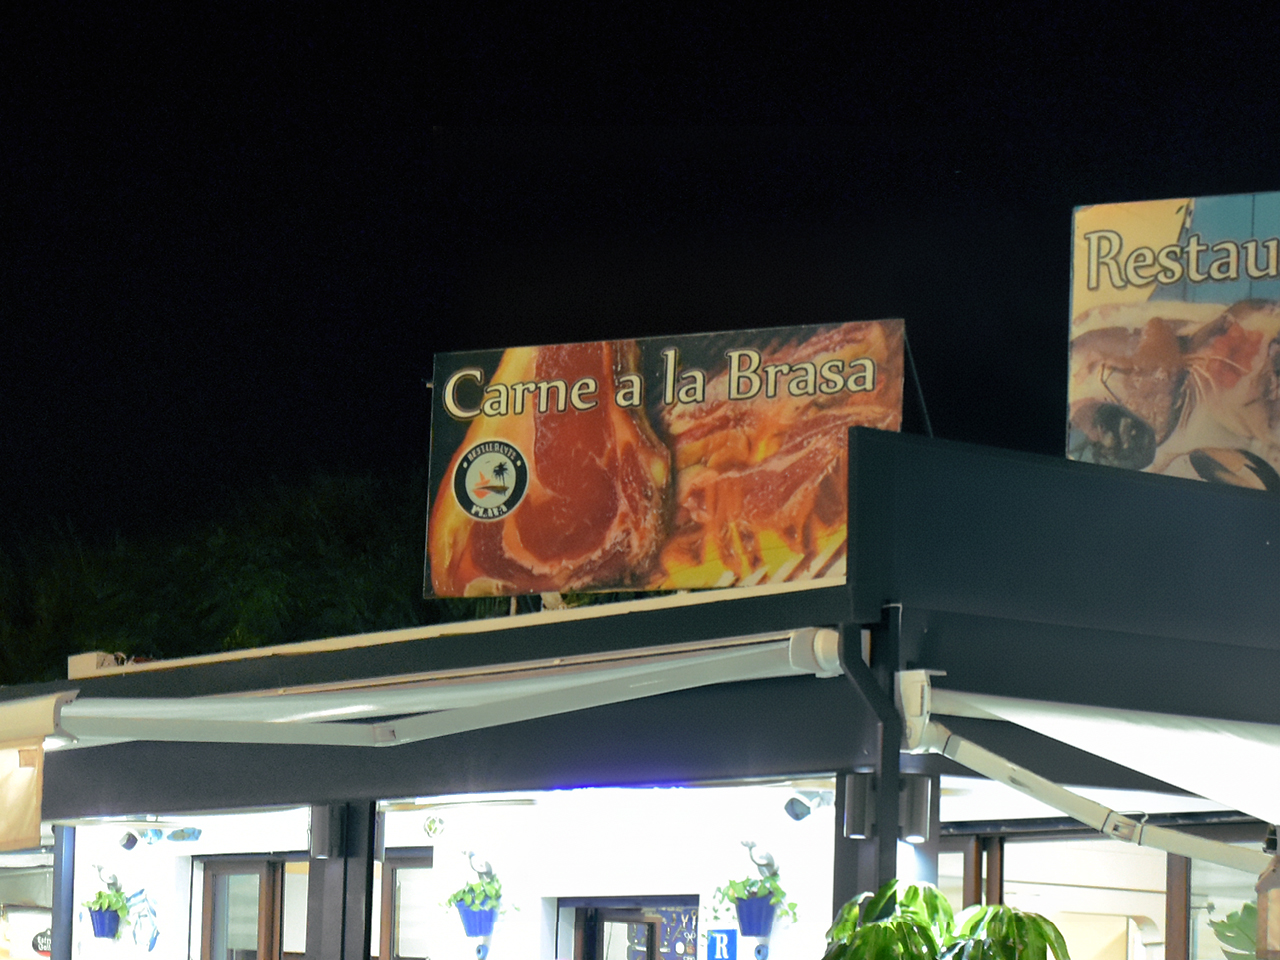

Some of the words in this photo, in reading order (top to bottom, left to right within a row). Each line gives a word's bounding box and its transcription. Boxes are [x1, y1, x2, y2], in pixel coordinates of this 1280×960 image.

[1084, 229, 1280, 290] Restau
[443, 368, 599, 420] Carne
[615, 373, 644, 409] a
[661, 347, 706, 405] la
[725, 348, 877, 401] Brasa
[714, 933, 729, 959] R
